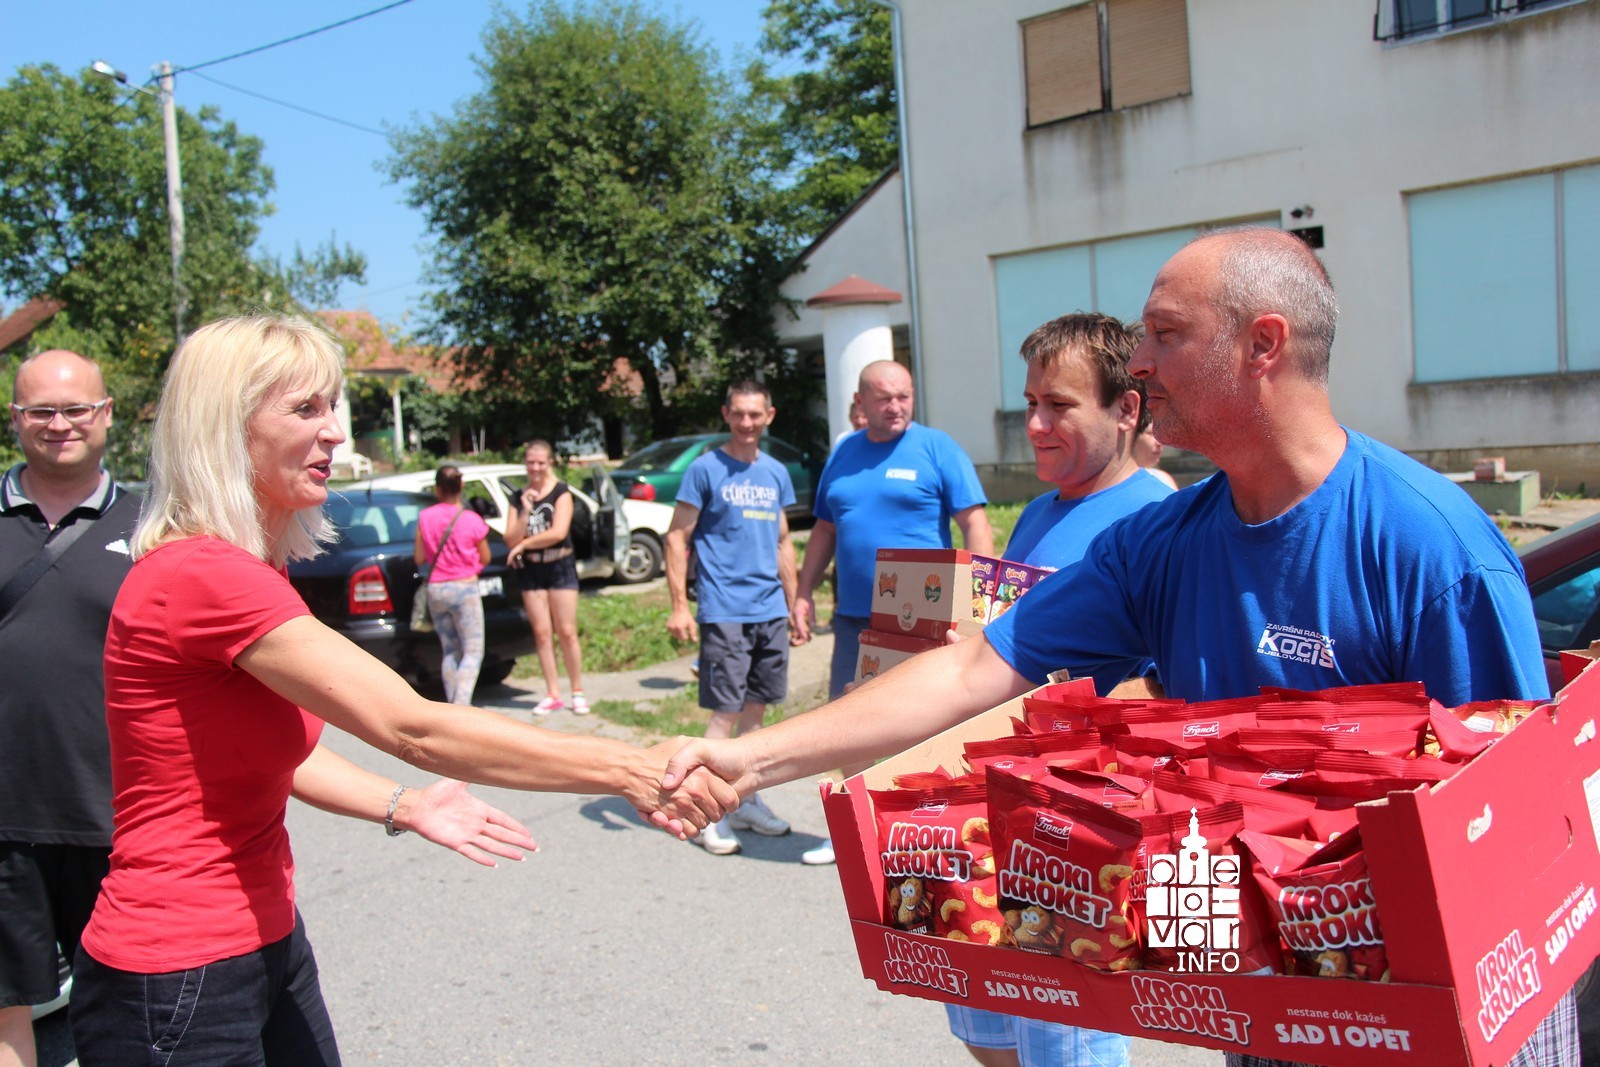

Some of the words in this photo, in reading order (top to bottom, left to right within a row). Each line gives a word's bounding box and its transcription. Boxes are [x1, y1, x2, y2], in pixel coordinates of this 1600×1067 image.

[1266, 623, 1303, 635] ZAVRŠNI
[1304, 630, 1335, 645] RADOVI
[1256, 648, 1311, 664] BJELOVAR
[1184, 724, 1218, 737] Franck
[888, 821, 956, 853] KROKI
[1035, 816, 1071, 837] Franck
[881, 848, 974, 883] KROKET
[1010, 839, 1092, 894] KROKI
[999, 869, 1113, 928] KROKET
[1279, 878, 1376, 922] KROK
[1545, 926, 1569, 965] SAD
[1565, 917, 1575, 938] I
[1571, 887, 1597, 930] OPET
[885, 932, 950, 967] KROKI
[1476, 929, 1524, 1003] KROKI
[884, 960, 968, 998] KROKET
[991, 969, 1021, 980] nestane
[1022, 973, 1036, 982] dok
[984, 980, 1020, 999] SAD
[1021, 985, 1031, 1000] I
[1033, 988, 1080, 1007] OPET
[1131, 975, 1226, 1012] KROKI
[1478, 947, 1541, 1042] KROKET
[1131, 1005, 1250, 1045] KROKET
[1287, 1008, 1329, 1019] nestane
[1332, 1009, 1353, 1021] dok
[1356, 1011, 1386, 1024] kažeš
[1275, 1023, 1325, 1044] SAD
[1328, 1025, 1341, 1046] I
[1344, 1027, 1410, 1051] OPET
